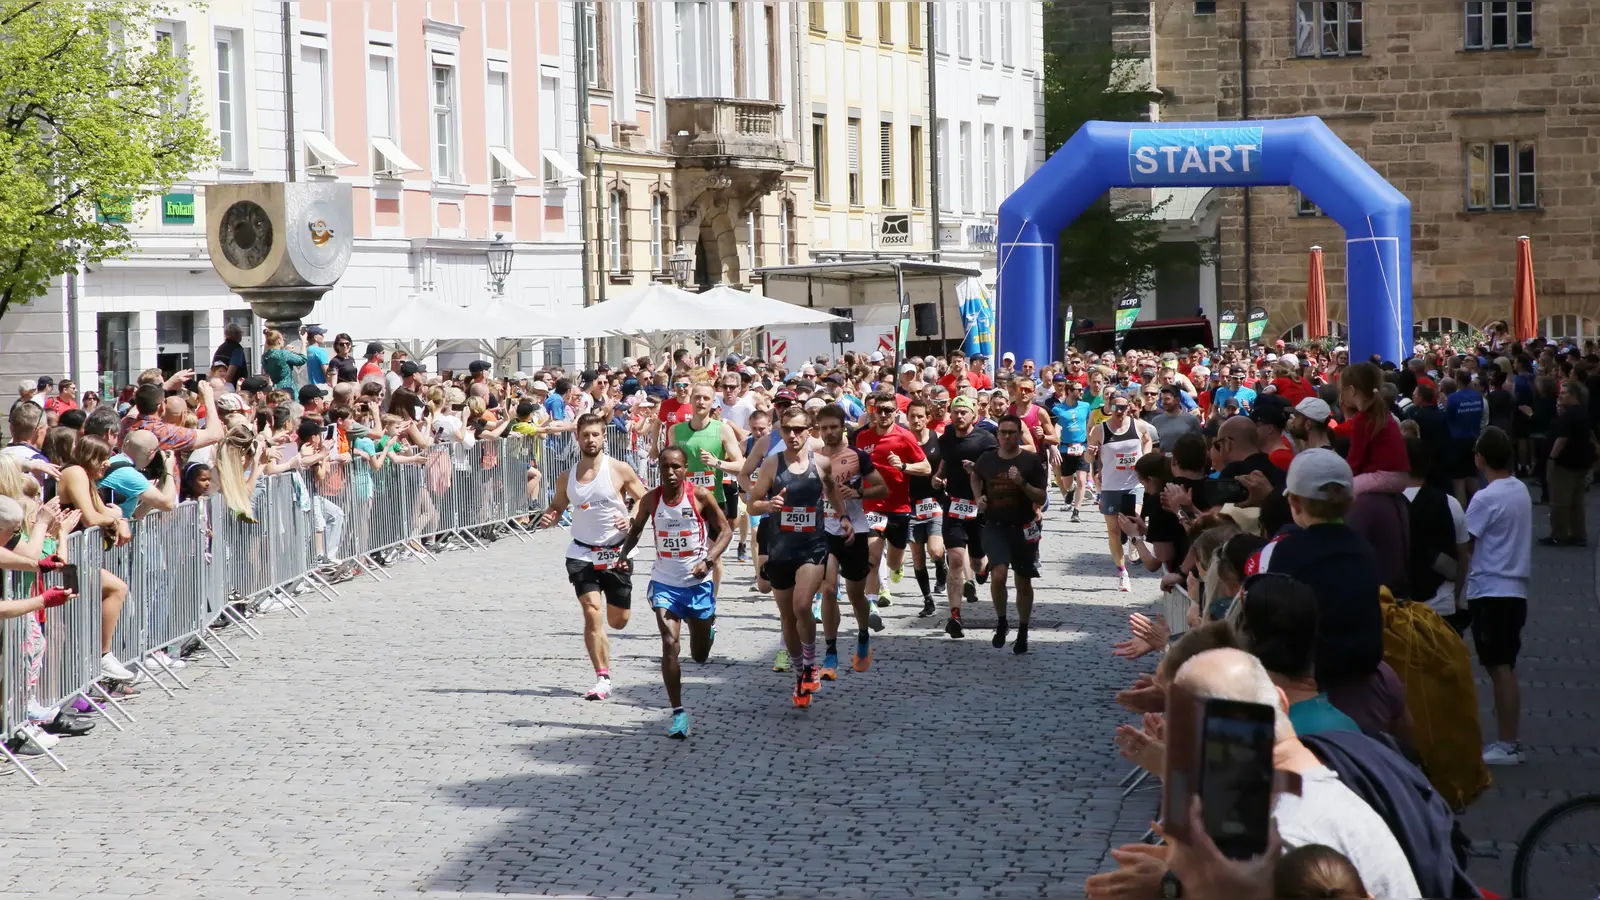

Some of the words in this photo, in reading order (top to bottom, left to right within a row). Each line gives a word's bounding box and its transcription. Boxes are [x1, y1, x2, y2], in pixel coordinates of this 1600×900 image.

[1135, 144, 1257, 174] START
[881, 234, 908, 244] rosset
[954, 503, 973, 513] 2635
[786, 513, 810, 523] 2501
[662, 538, 688, 548] 2513
[597, 550, 620, 561] 2553
